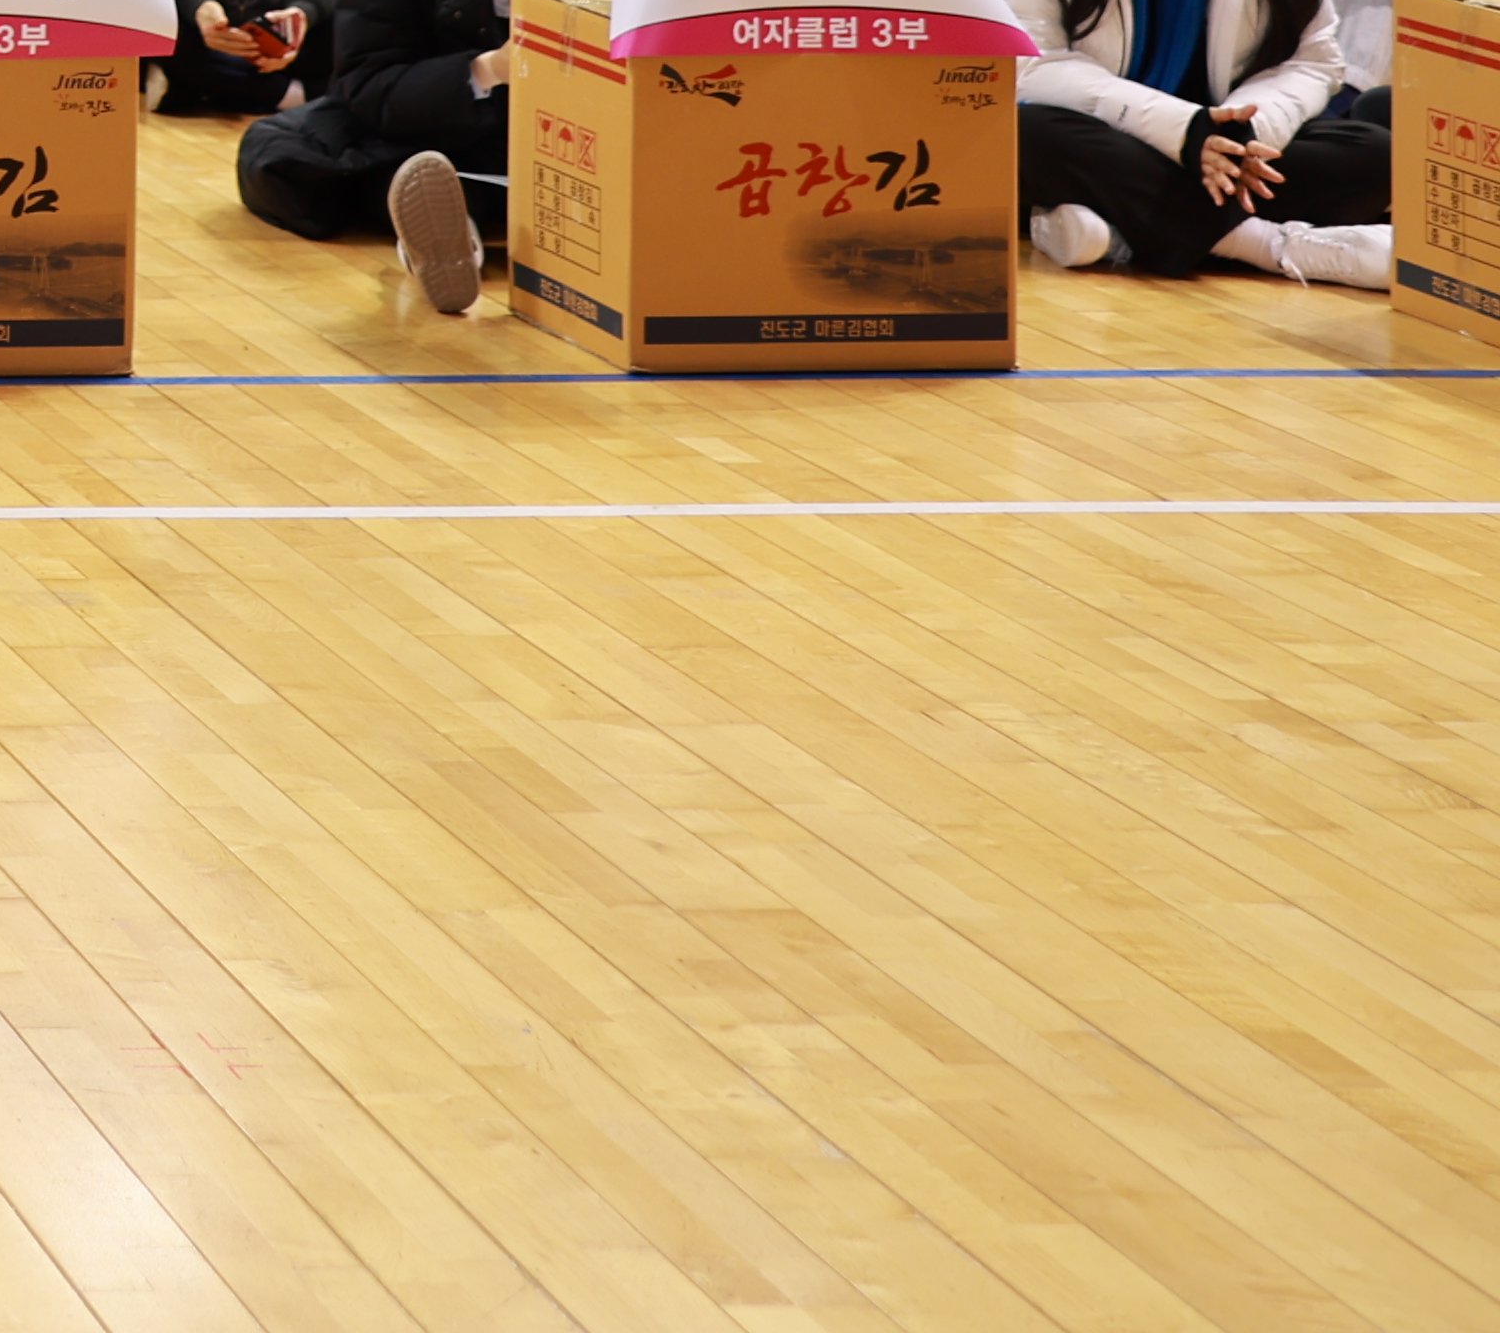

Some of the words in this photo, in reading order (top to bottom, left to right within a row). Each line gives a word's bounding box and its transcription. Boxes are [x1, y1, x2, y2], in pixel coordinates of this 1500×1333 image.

[732, 17, 858, 49] 여자클럽
[871, 18, 930, 50] 3부
[52, 75, 107, 90] Jindo
[934, 68, 988, 85] Jindo
[716, 139, 941, 217] 곱창김
[759, 320, 807, 338] 진도군
[815, 319, 895, 337] 마른김협회
